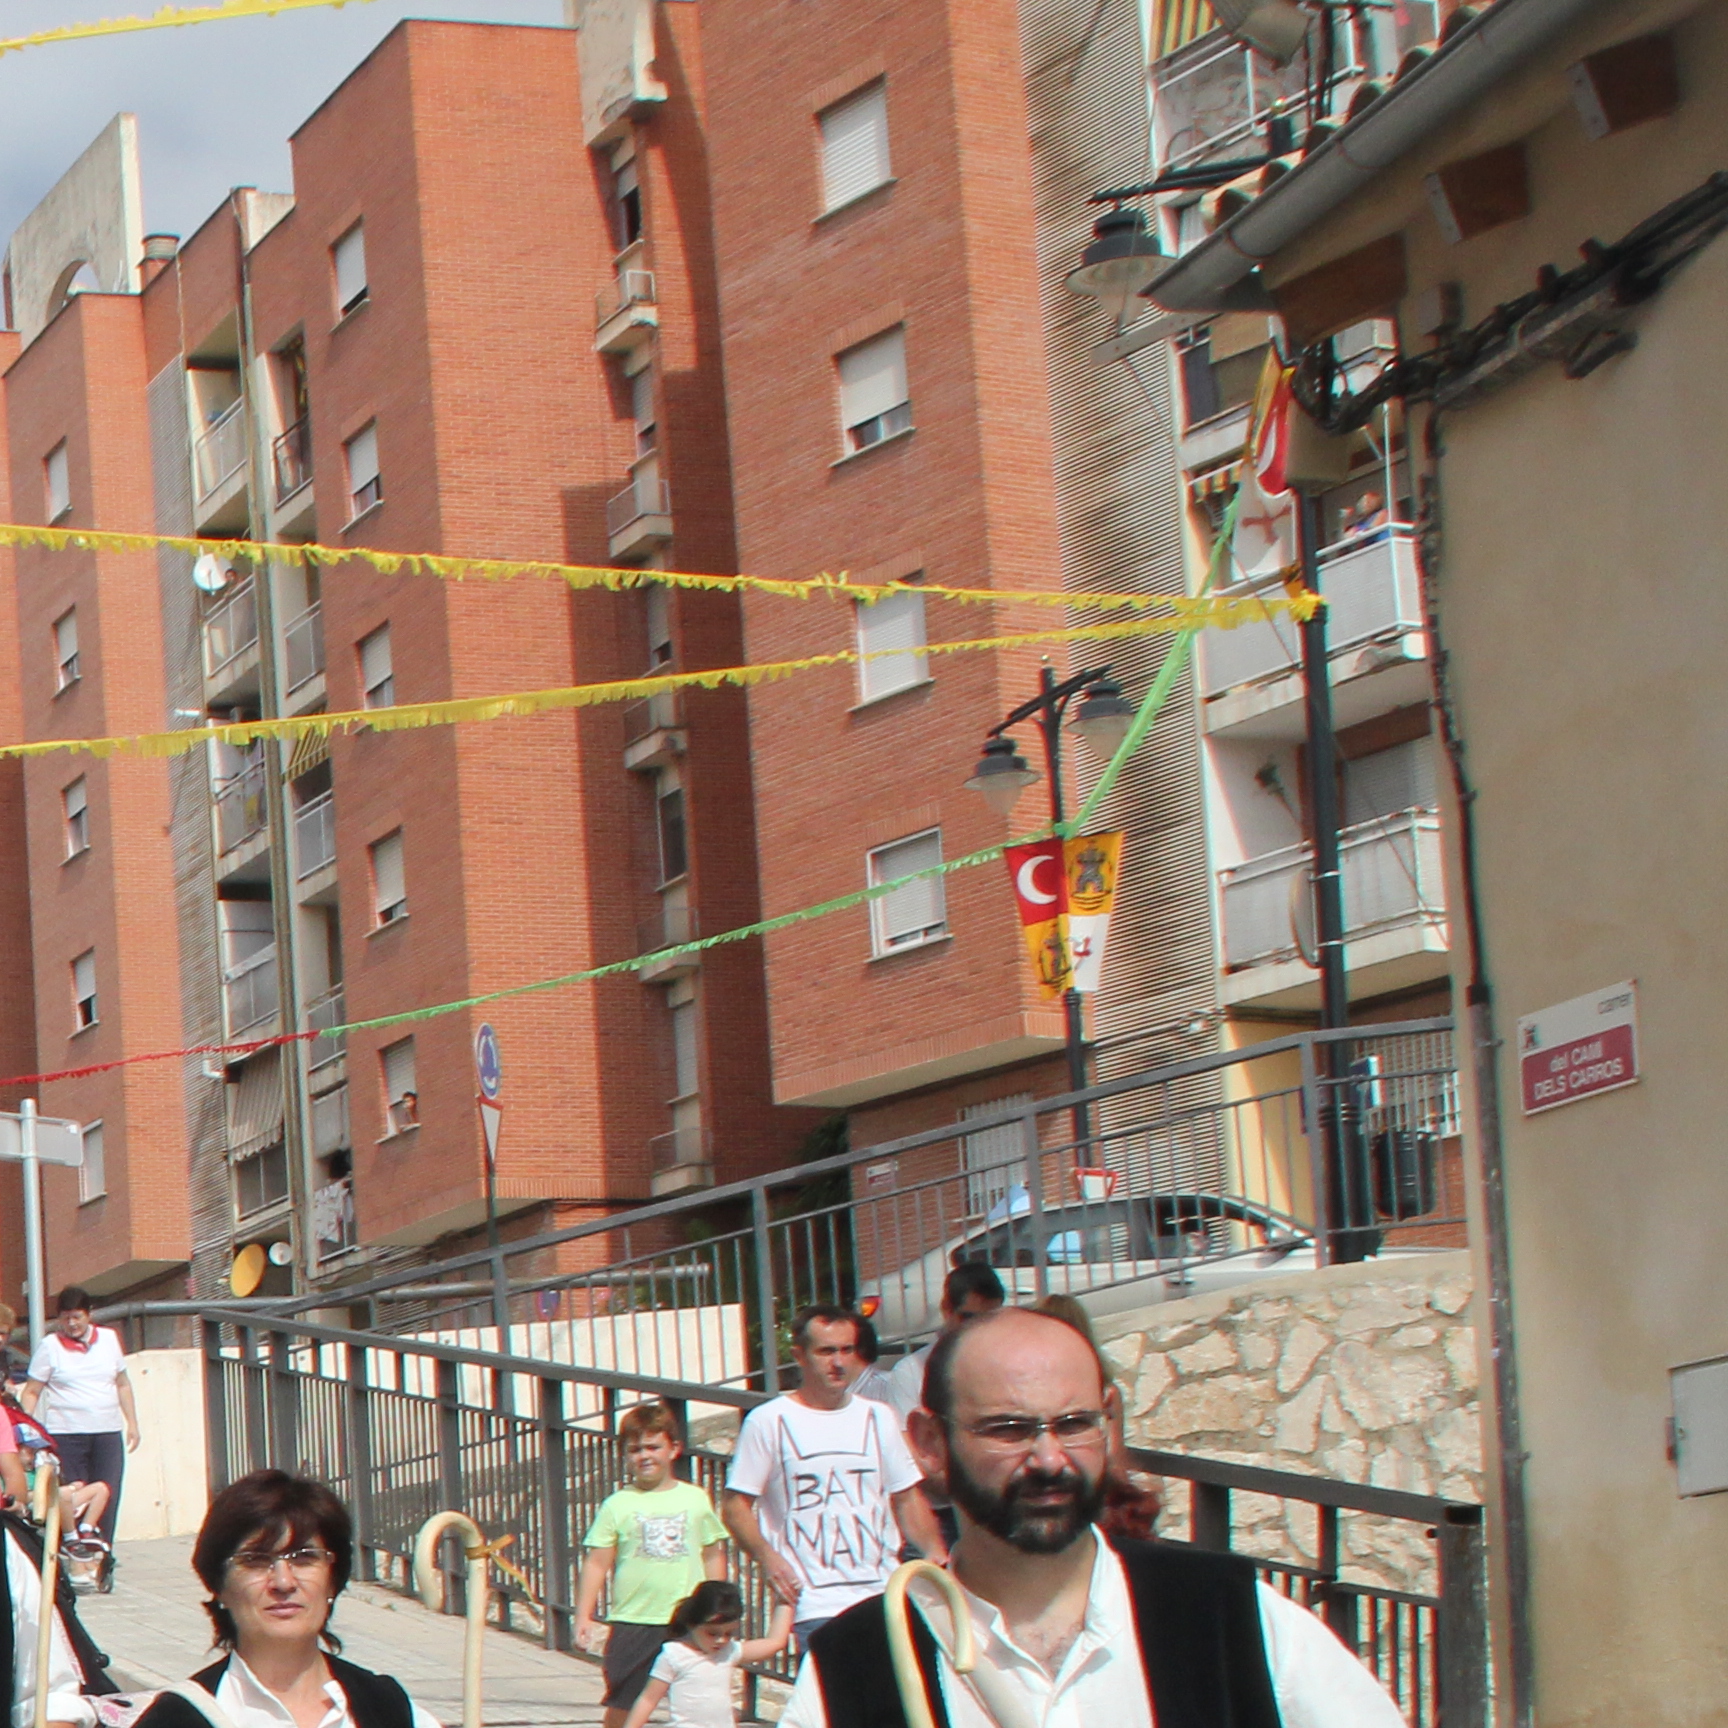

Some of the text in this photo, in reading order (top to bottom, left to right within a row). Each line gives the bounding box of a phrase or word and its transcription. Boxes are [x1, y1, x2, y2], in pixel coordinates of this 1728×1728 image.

[1533, 1057, 1624, 1101] DELS CARROS
[791, 1467, 878, 1511] BAT
[791, 1504, 887, 1570] MAN
